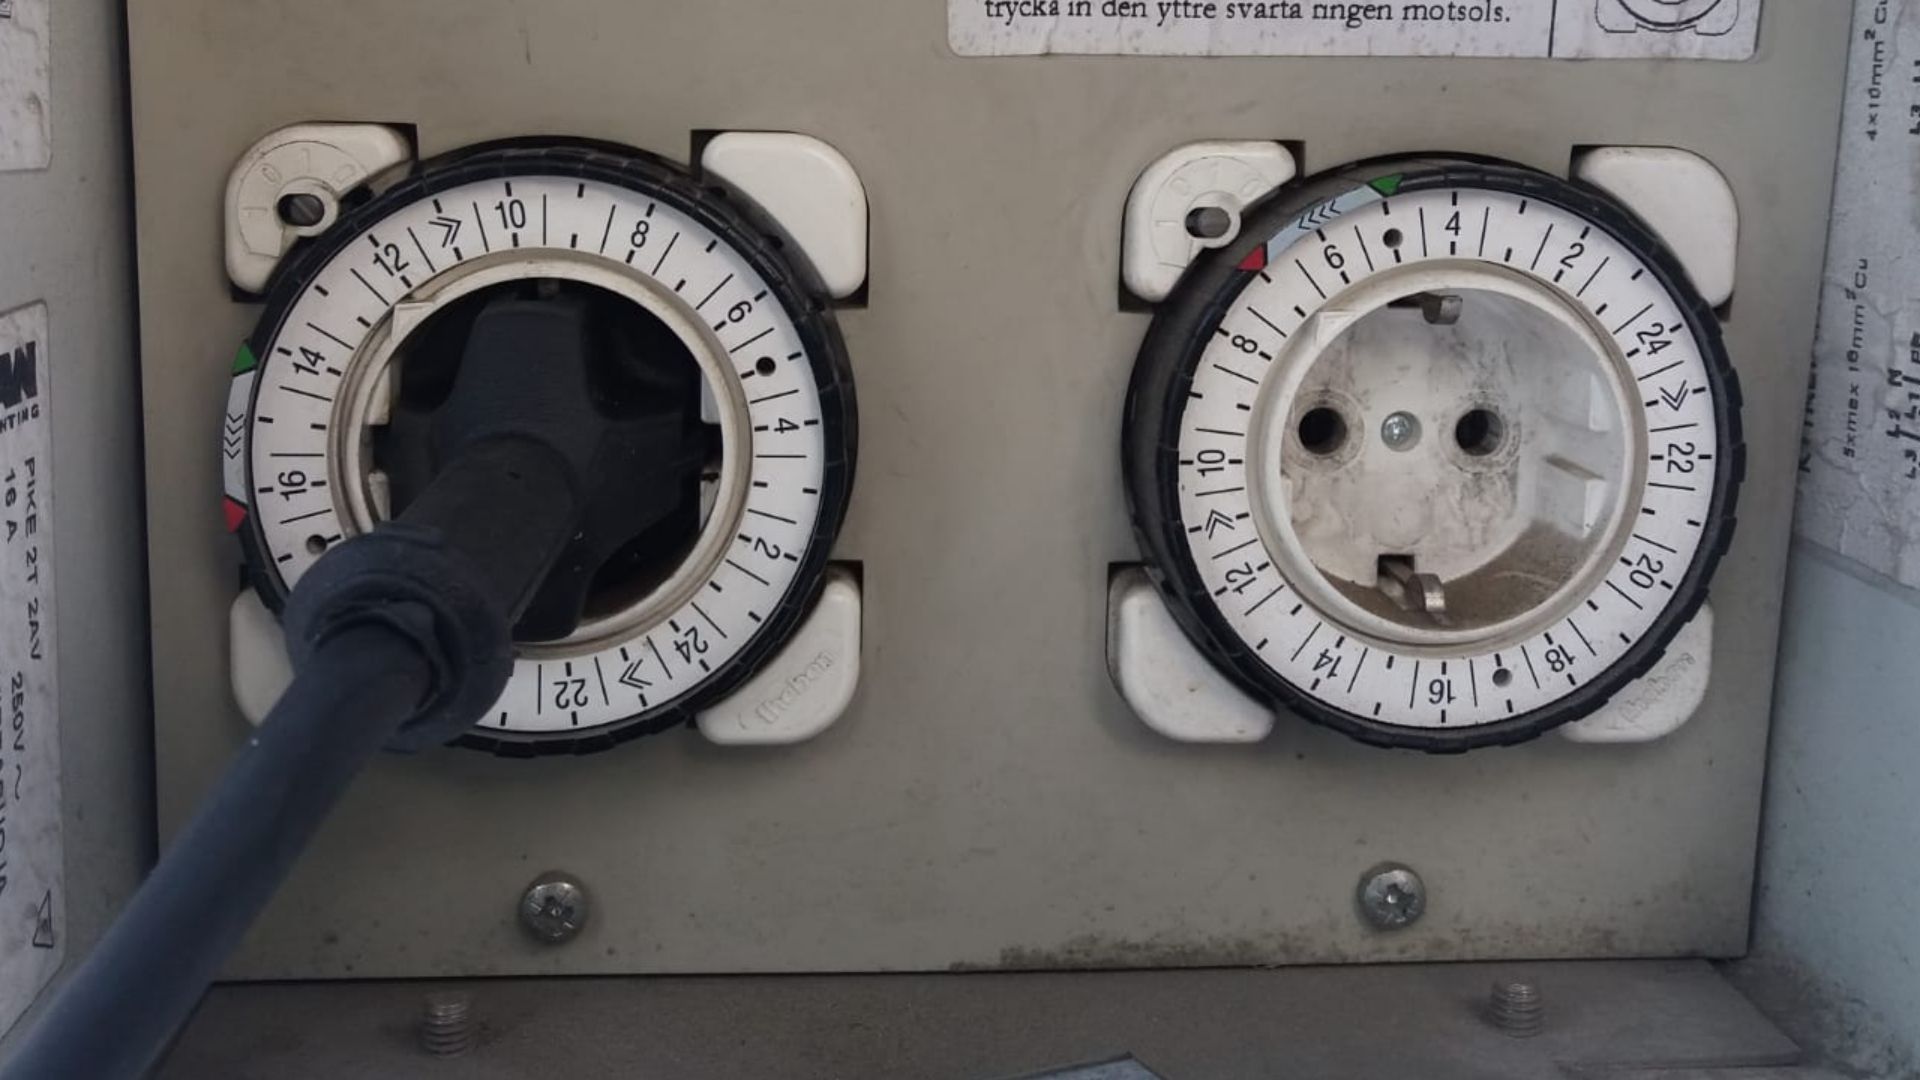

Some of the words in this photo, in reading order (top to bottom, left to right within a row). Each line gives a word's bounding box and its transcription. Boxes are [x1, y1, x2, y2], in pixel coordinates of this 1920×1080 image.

[985, 0, 1059, 26] trycka
[1101, 0, 1147, 18] den
[1158, 0, 1217, 27] yttre
[1226, 1, 1302, 20] svarta
[1402, 0, 1511, 23] motsols.
[494, 198, 527, 230] 10
[1444, 210, 1462, 237] 4
[630, 219, 650, 249] 8
[372, 242, 410, 278] 12
[1323, 243, 1345, 270] 6
[1559, 241, 1586, 270] 2
[727, 299, 753, 324] 6
[1230, 333, 1259, 355] 8
[1635, 321, 1673, 356] 24
[291, 345, 327, 376] 14
[773, 417, 801, 435] 4
[1196, 448, 1226, 479] 10
[1666, 441, 1696, 474] 22
[5, 467, 17, 507] 16
[25, 456, 38, 538] PIKE
[277, 470, 308, 502] 16
[6, 520, 18, 544] A
[753, 536, 781, 561] 2
[26, 547, 38, 584] 2T
[1224, 561, 1258, 596] 12
[1628, 552, 1665, 590] 20
[28, 597, 42, 660] 2AV
[672, 625, 709, 665] 24
[1544, 643, 1577, 673] 18
[1311, 647, 1343, 680] 14
[552, 677, 589, 711] 22
[1428, 678, 1457, 705] 16
[11, 671, 25, 751] 250V
